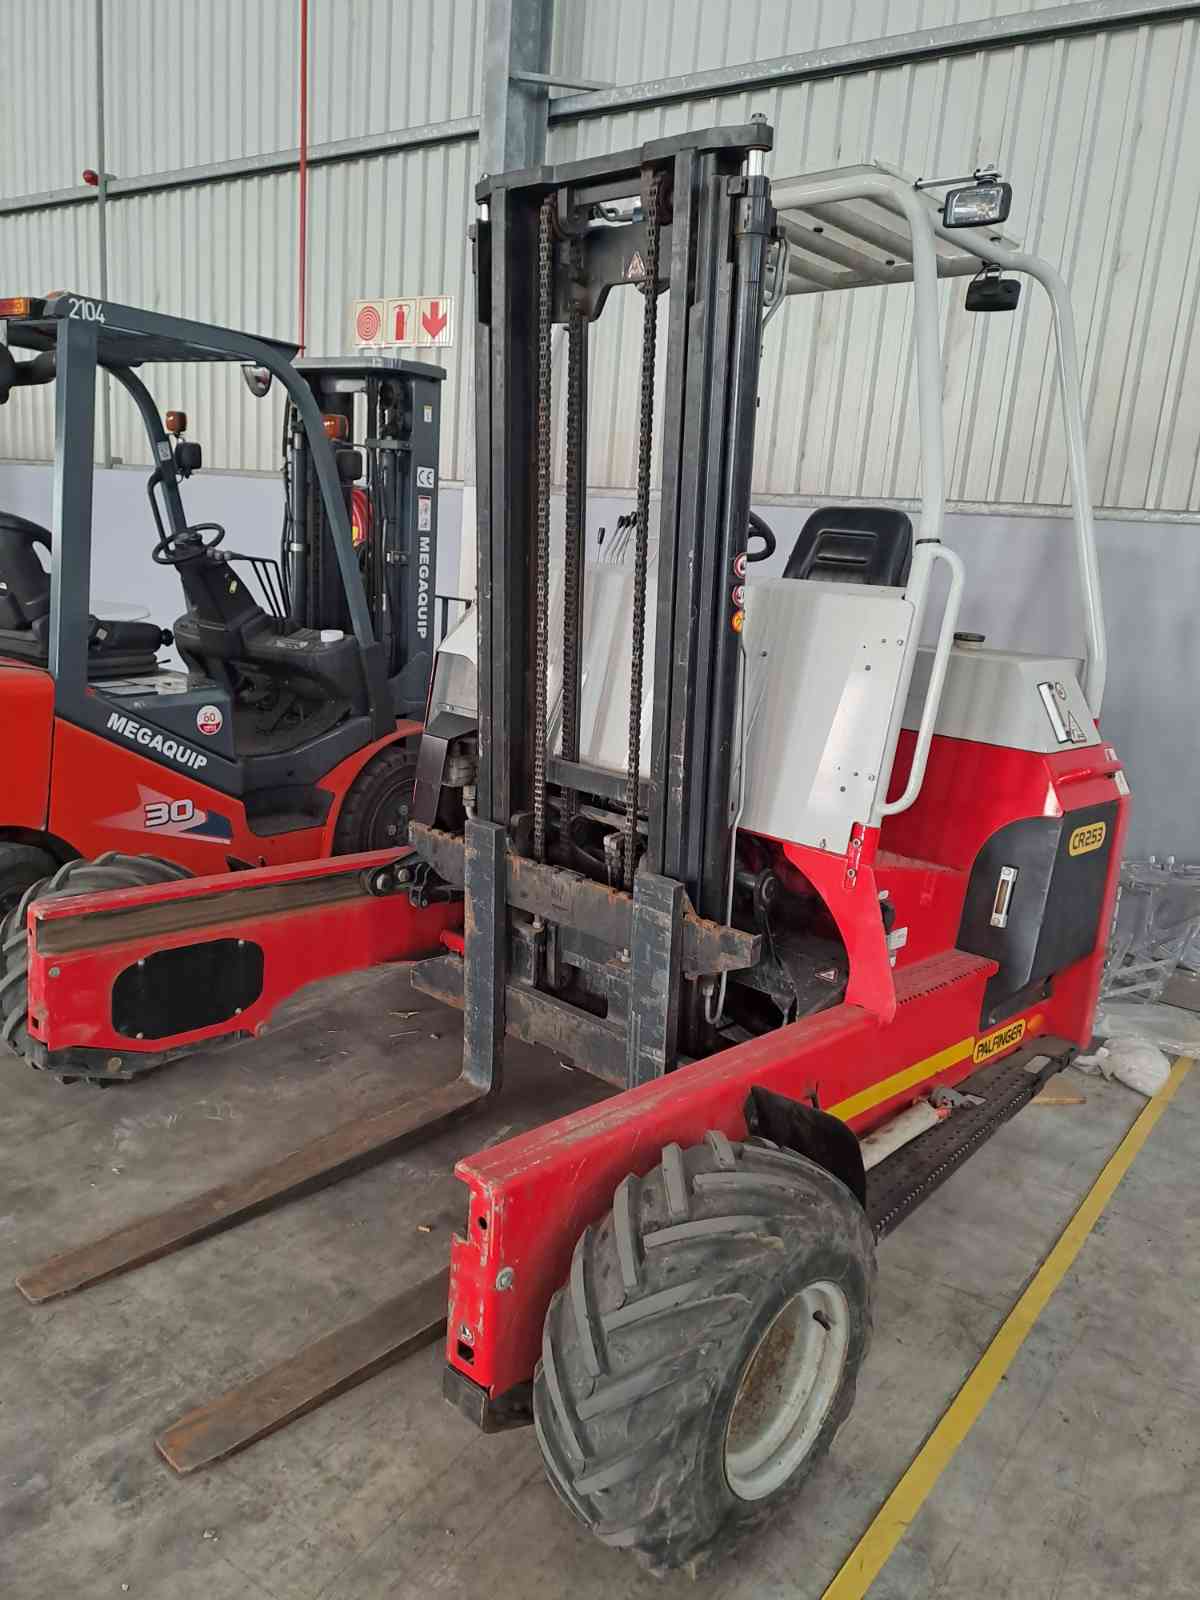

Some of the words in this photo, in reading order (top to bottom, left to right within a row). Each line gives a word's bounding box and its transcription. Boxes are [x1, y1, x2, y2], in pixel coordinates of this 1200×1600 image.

[69, 298, 105, 323] 2104
[417, 536, 430, 639] MEGAQUIP
[107, 712, 208, 769] MEGAQUIP
[144, 799, 194, 827] 30
[1072, 827, 1103, 850] CR253
[976, 1023, 1023, 1060] PALFINGER
